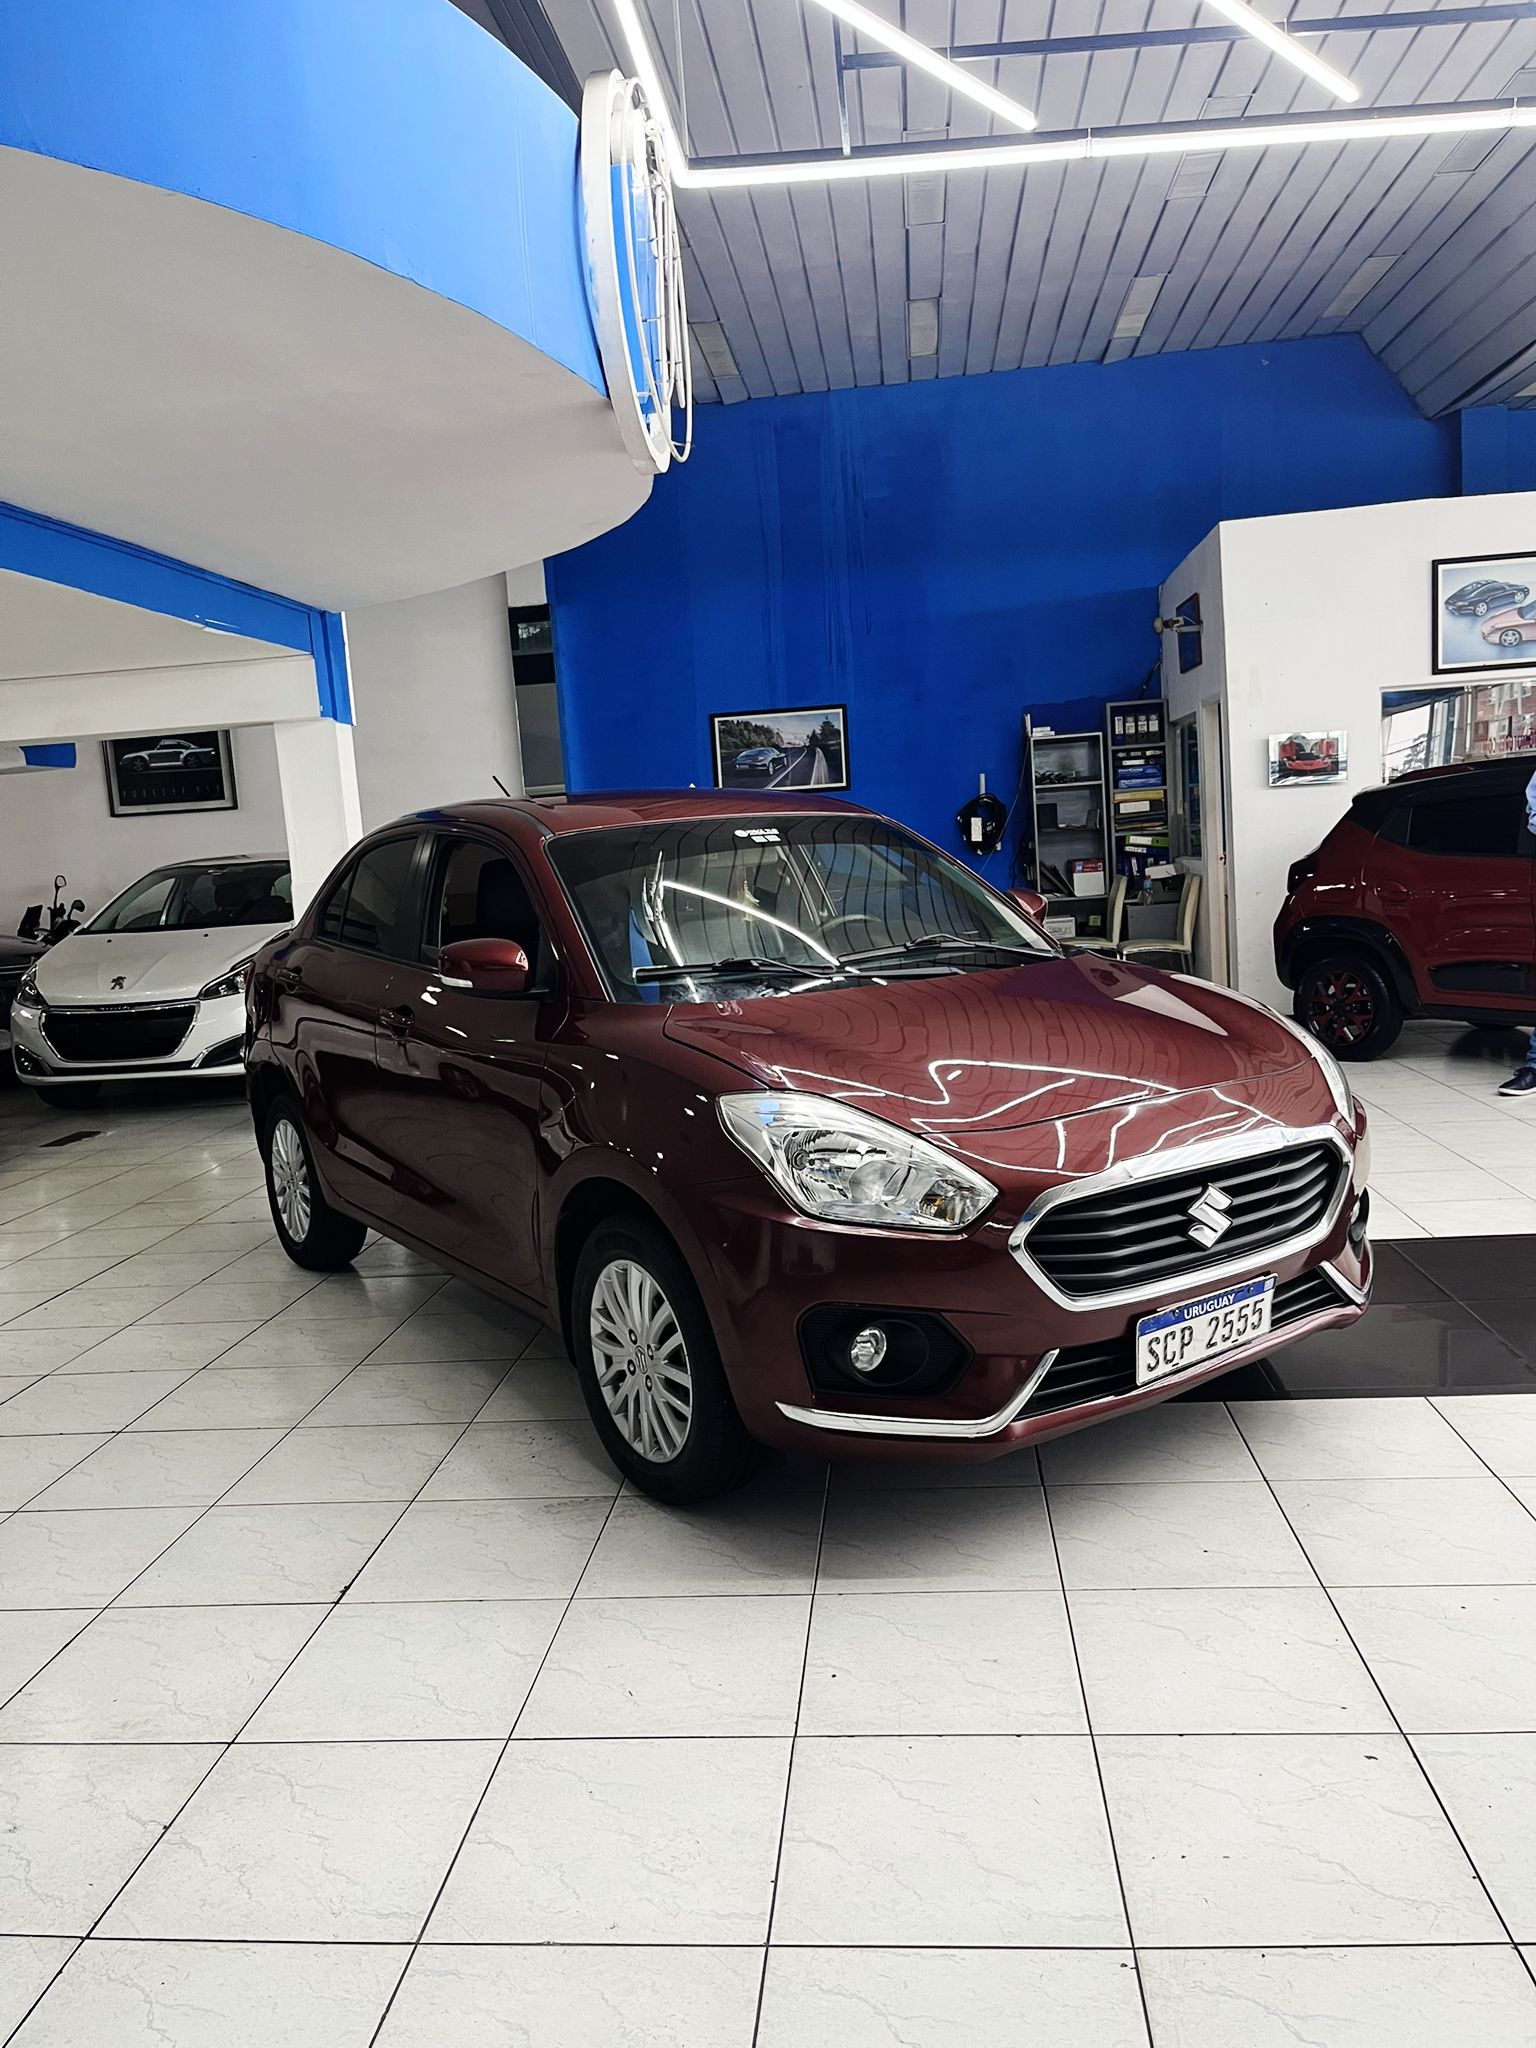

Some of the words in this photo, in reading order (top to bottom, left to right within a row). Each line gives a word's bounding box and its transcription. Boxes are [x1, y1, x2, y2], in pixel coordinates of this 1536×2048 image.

[1183, 1293, 1236, 1320] URUGUAY
[1147, 1325, 1193, 1372] SCP
[1206, 1298, 1265, 1349] 2555
